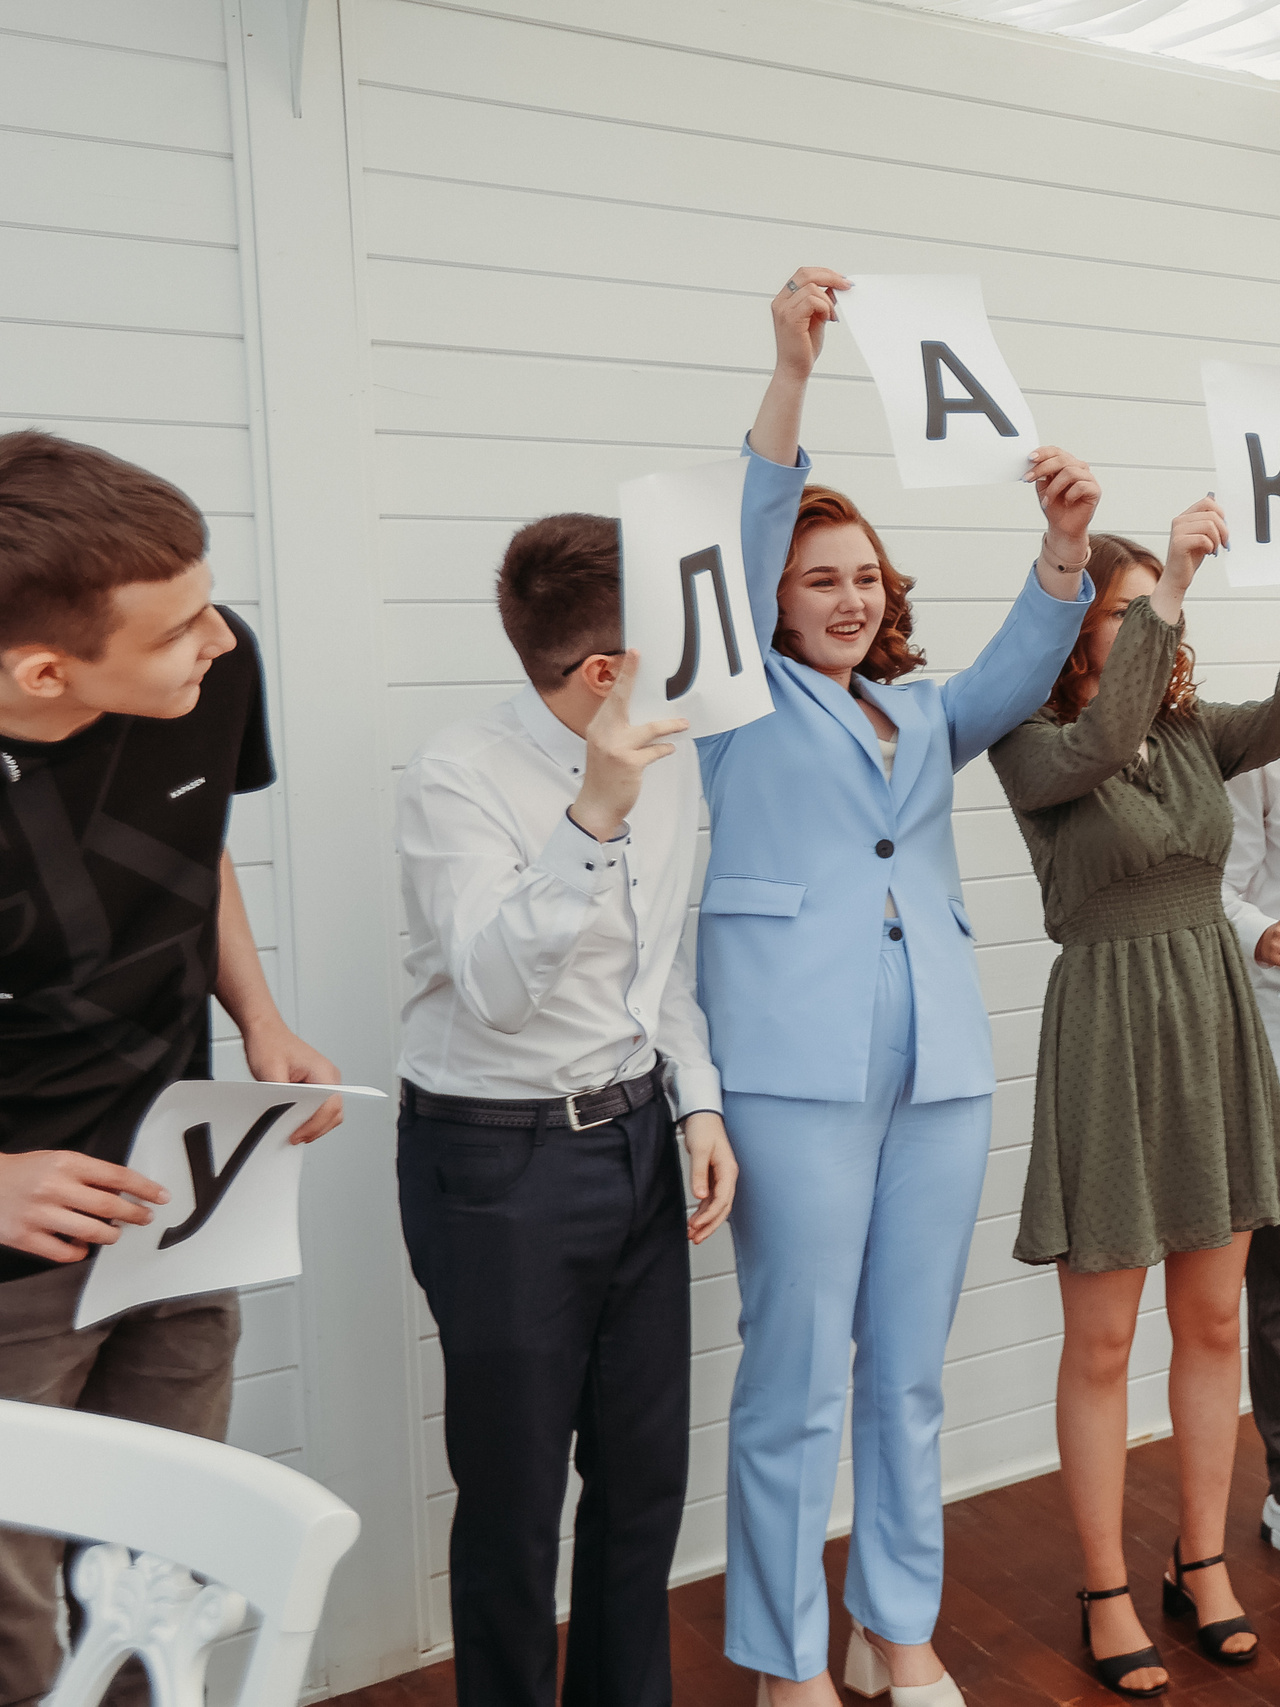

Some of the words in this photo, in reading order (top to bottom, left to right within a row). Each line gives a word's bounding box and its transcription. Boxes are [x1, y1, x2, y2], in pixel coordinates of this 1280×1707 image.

[919, 340, 1018, 440] А
[665, 544, 743, 701] Л
[157, 1101, 298, 1251] У
